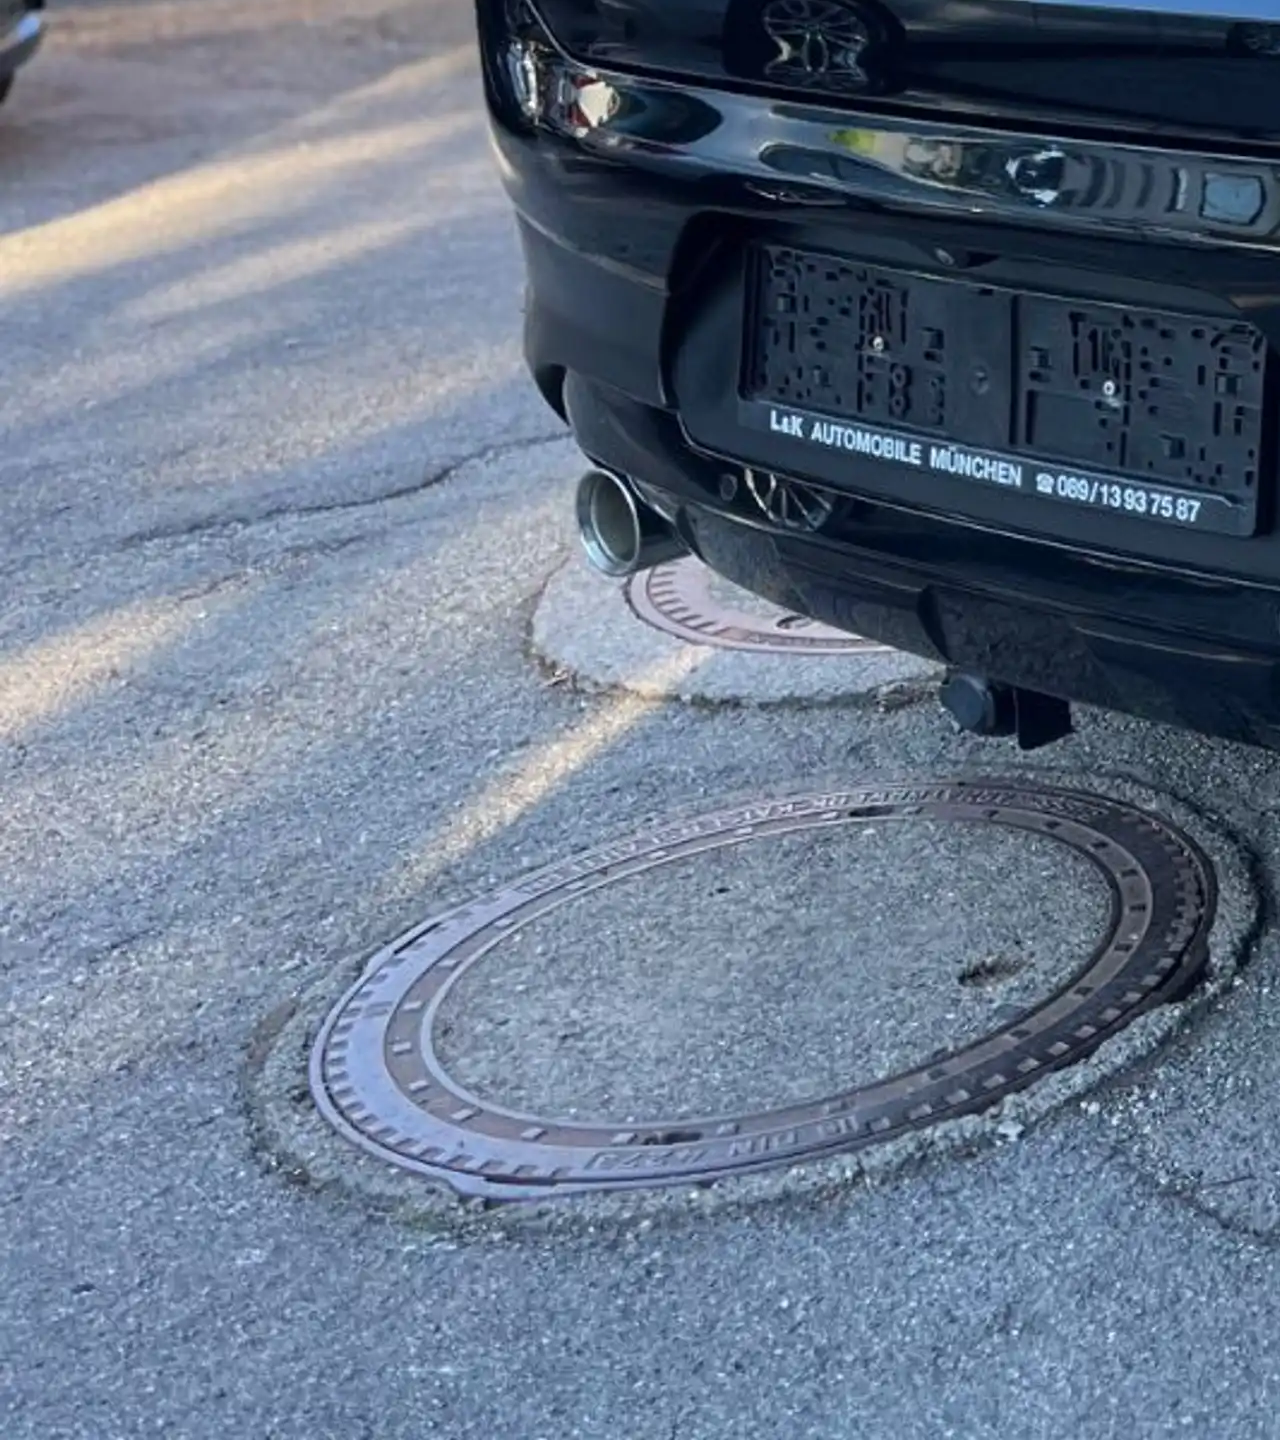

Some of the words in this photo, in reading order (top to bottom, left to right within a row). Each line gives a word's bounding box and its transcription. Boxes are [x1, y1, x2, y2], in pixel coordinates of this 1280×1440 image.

[770, 410, 803, 438] L&K
[811, 422, 922, 465] AUTOMOBILE
[930, 446, 1022, 487] MÜNCHEN
